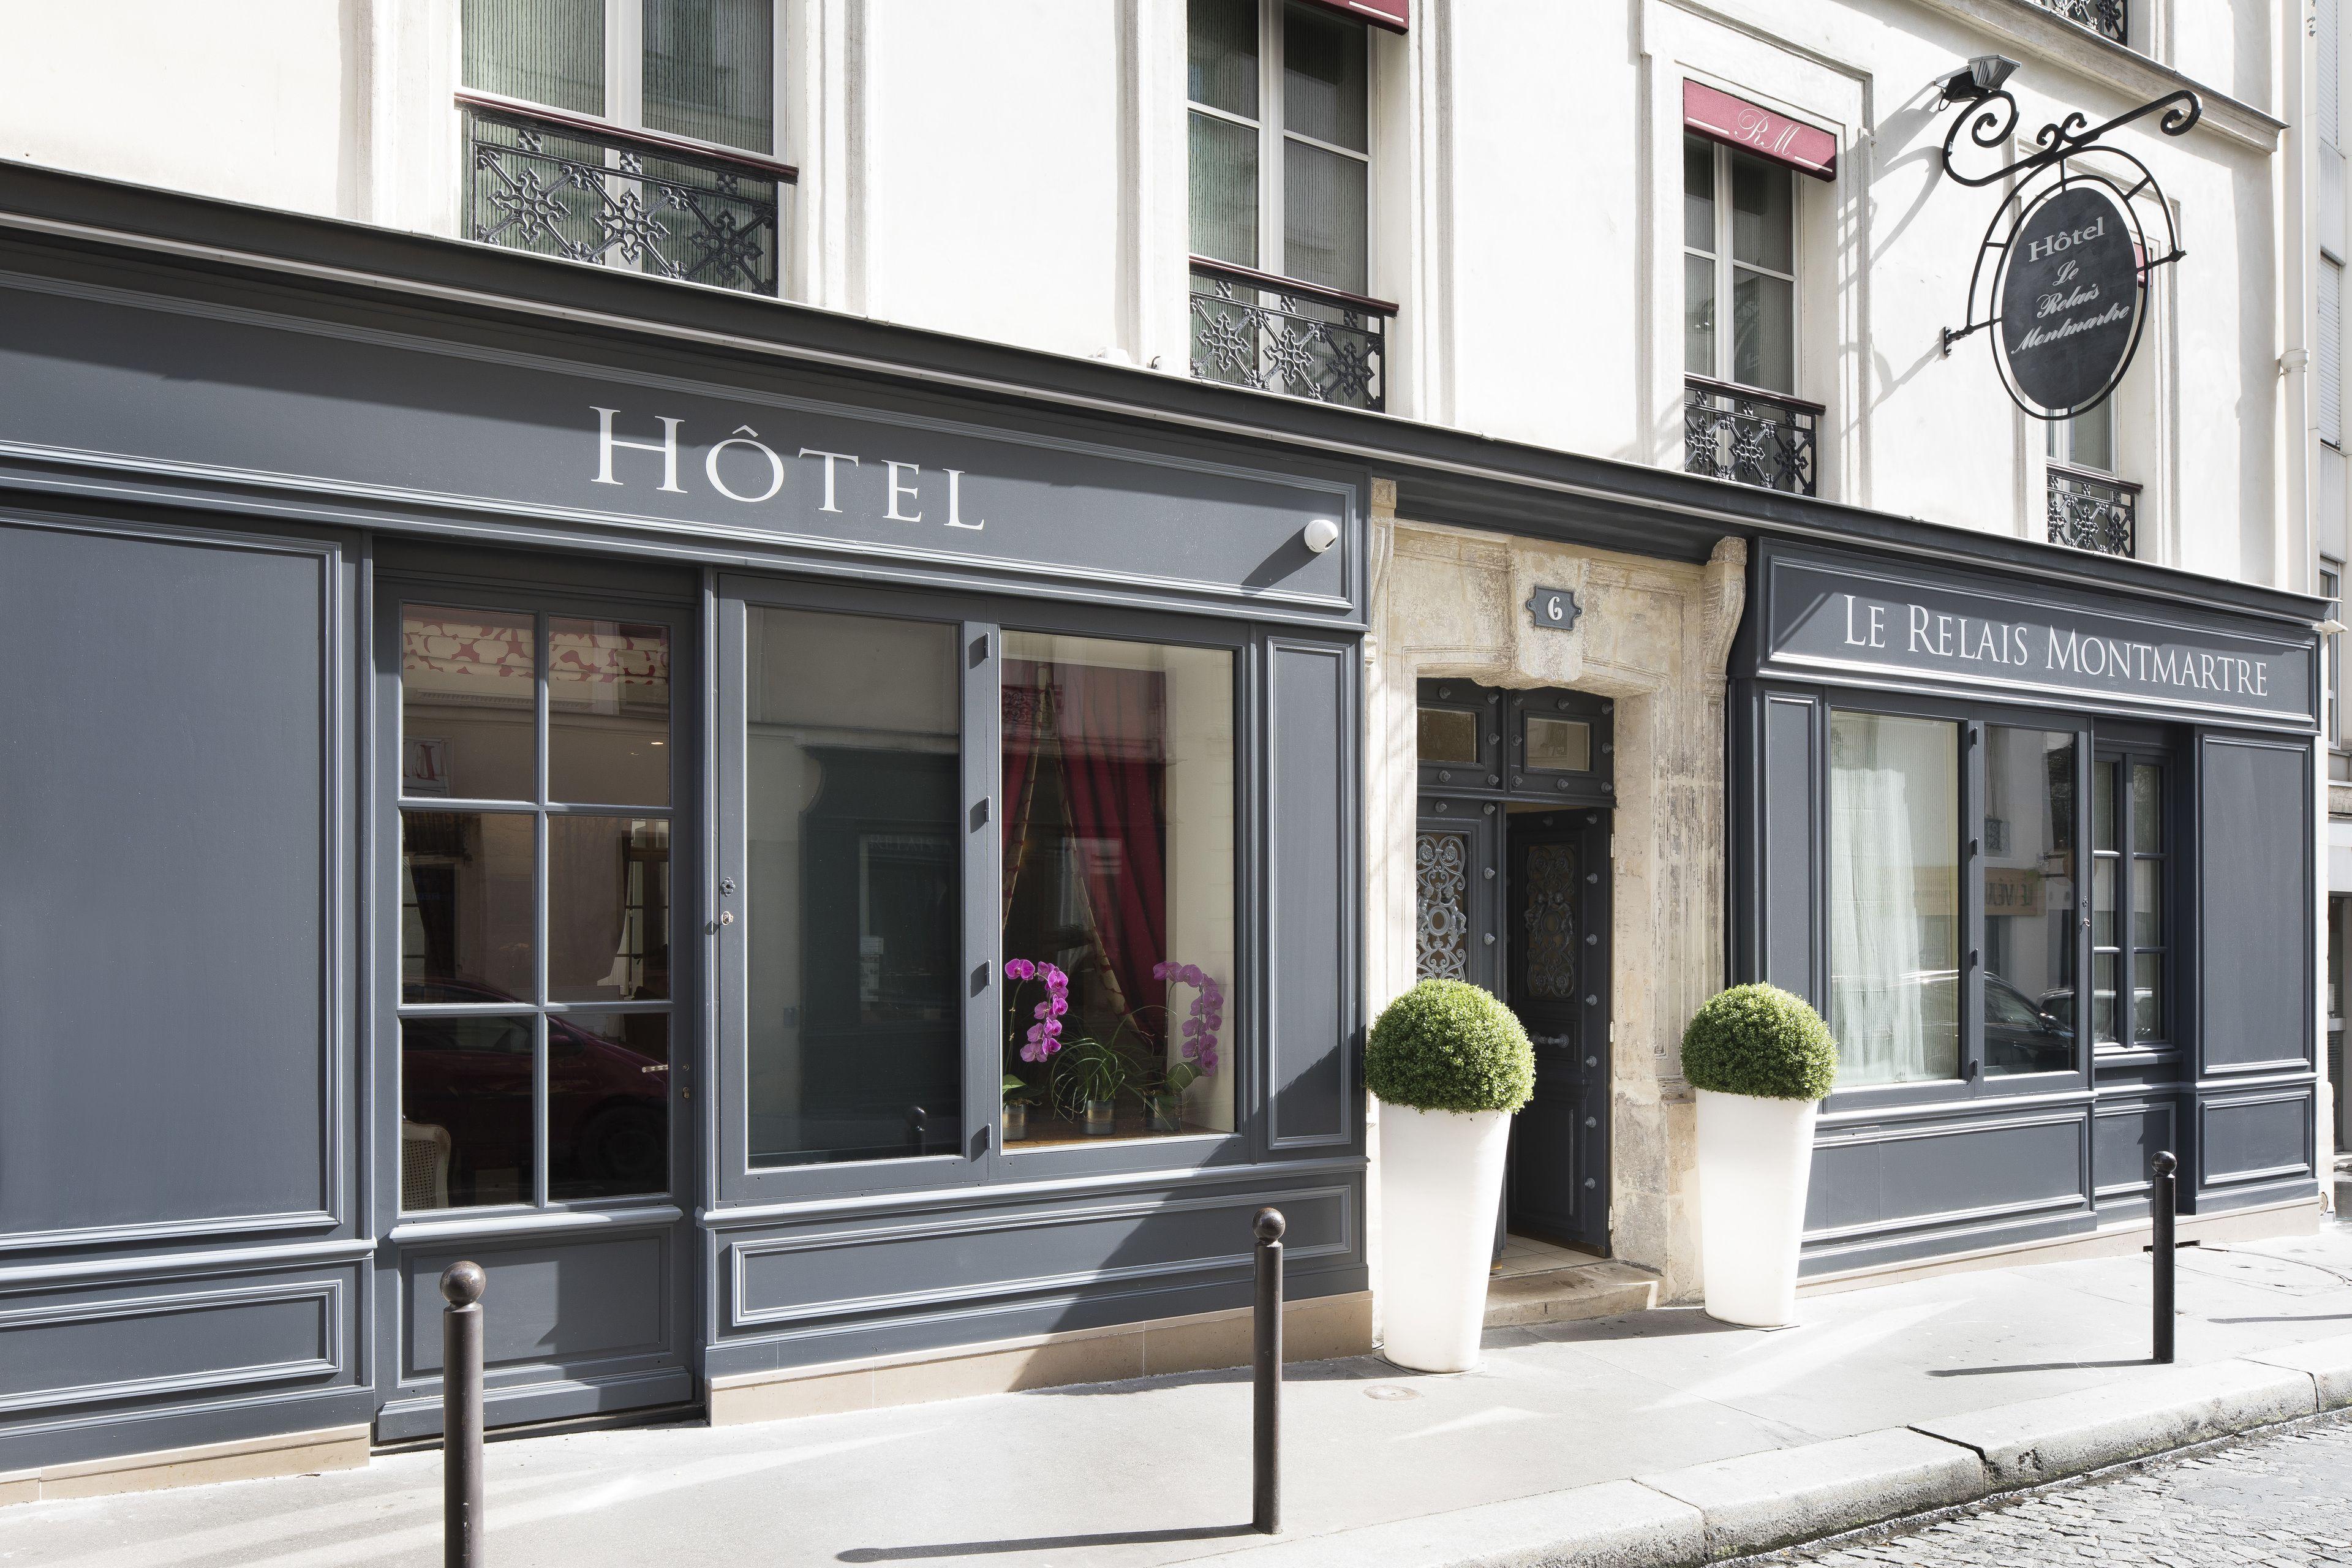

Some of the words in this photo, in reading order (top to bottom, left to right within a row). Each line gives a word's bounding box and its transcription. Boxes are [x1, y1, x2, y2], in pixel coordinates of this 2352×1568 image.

[2027, 216, 2106, 263] Hôtel
[2052, 259, 2079, 287] Le
[2036, 282, 2101, 319] Relais
[2010, 302, 2130, 355] Montmartre
[589, 405, 985, 531] HÔTEL
[1547, 596, 1563, 620] 6
[1843, 594, 1886, 649] LE
[1906, 603, 2030, 666] RELAIS
[2045, 624, 2269, 697] MONTMARTRE
